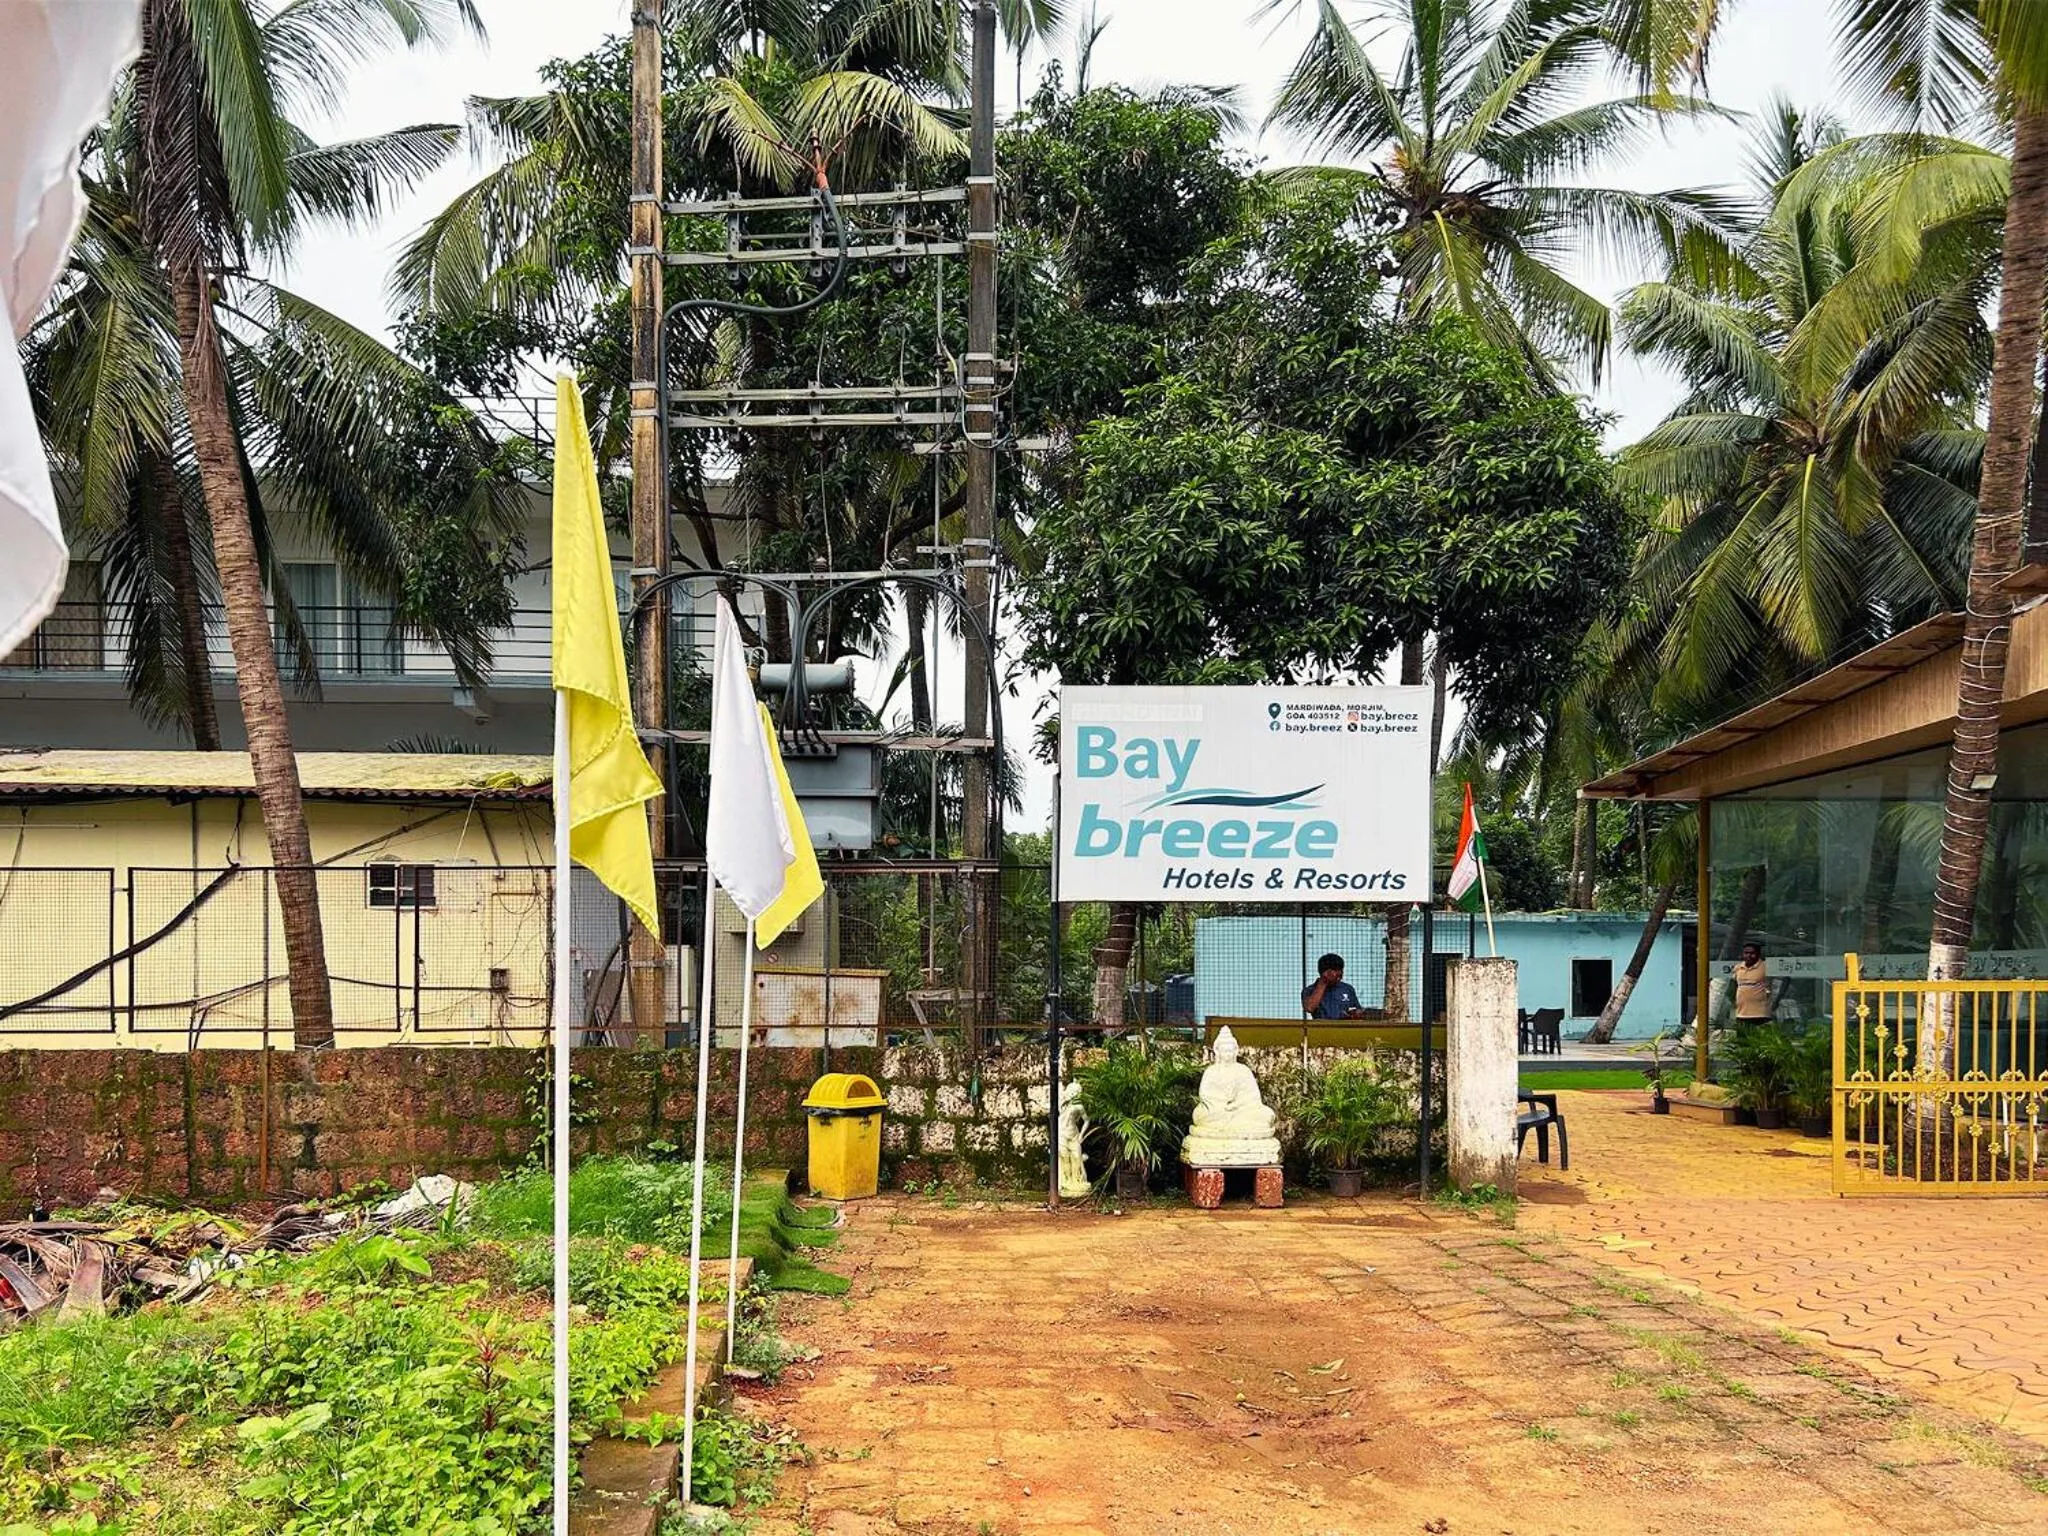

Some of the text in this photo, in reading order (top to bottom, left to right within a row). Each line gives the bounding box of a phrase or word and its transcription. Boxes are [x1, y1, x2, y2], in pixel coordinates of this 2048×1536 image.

[1361, 712, 1418, 721] bay.breez
[1285, 723, 1343, 733] bay.breez
[1361, 723, 1418, 733] bay.breez
[1077, 726, 1201, 793] Bay
[1074, 804, 1339, 859] breeze
[1163, 868, 1407, 890] Hotels & Resorts
